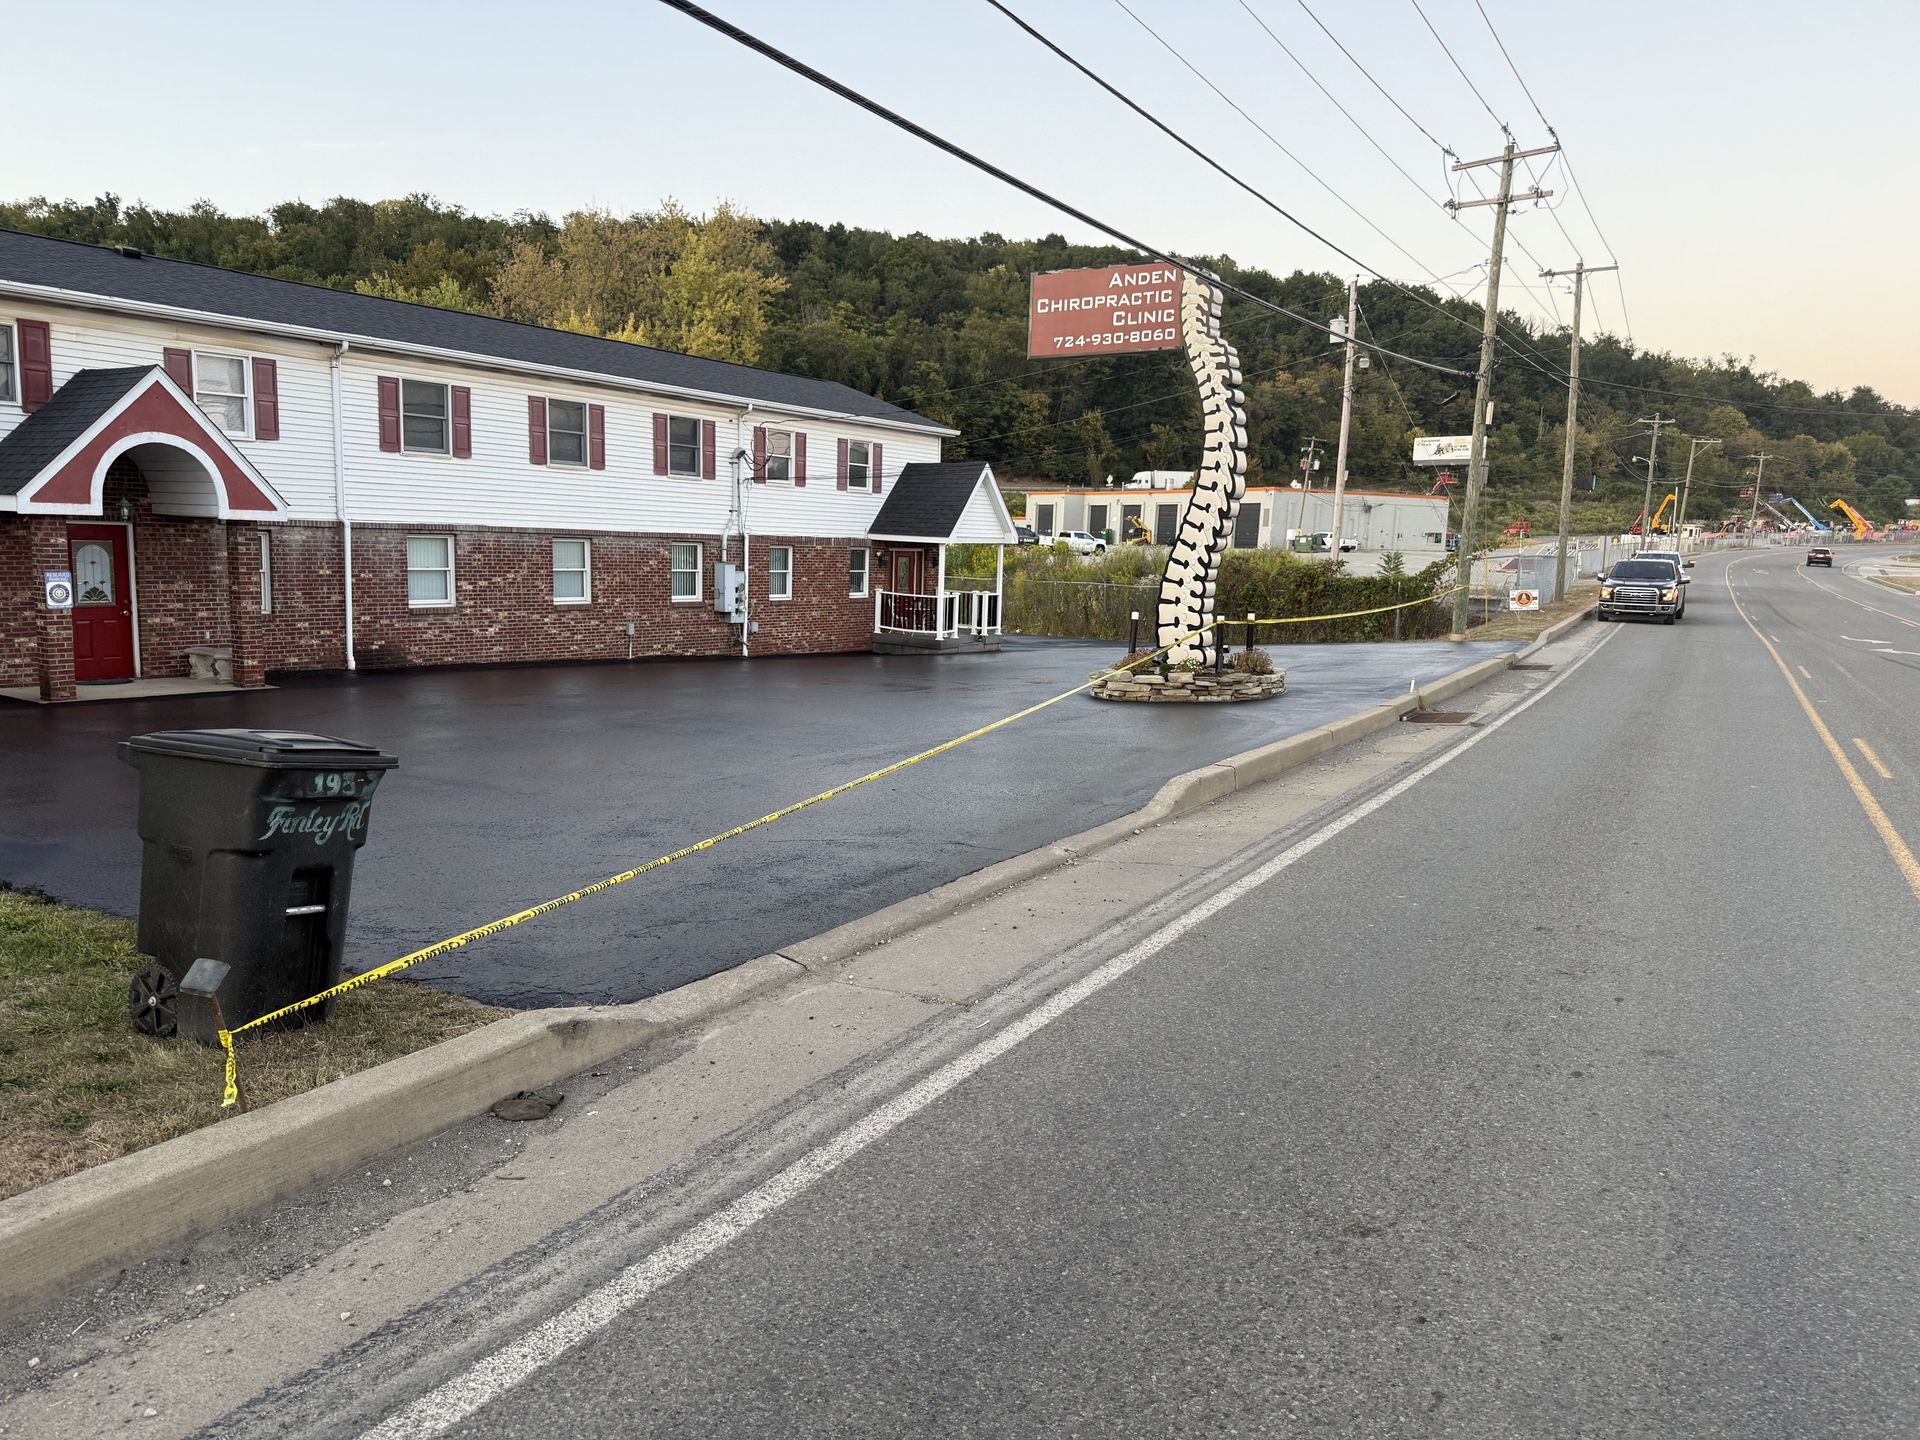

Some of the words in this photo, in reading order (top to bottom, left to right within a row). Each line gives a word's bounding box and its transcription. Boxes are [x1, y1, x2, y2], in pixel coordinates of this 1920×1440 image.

[1037, 290, 1173, 314] CHIROPRACTIC
[1112, 309, 1175, 326] CLINIC
[1053, 328, 1176, 349] 724-930-8060
[258, 806, 340, 846] Finley
[338, 801, 371, 841] Rd
